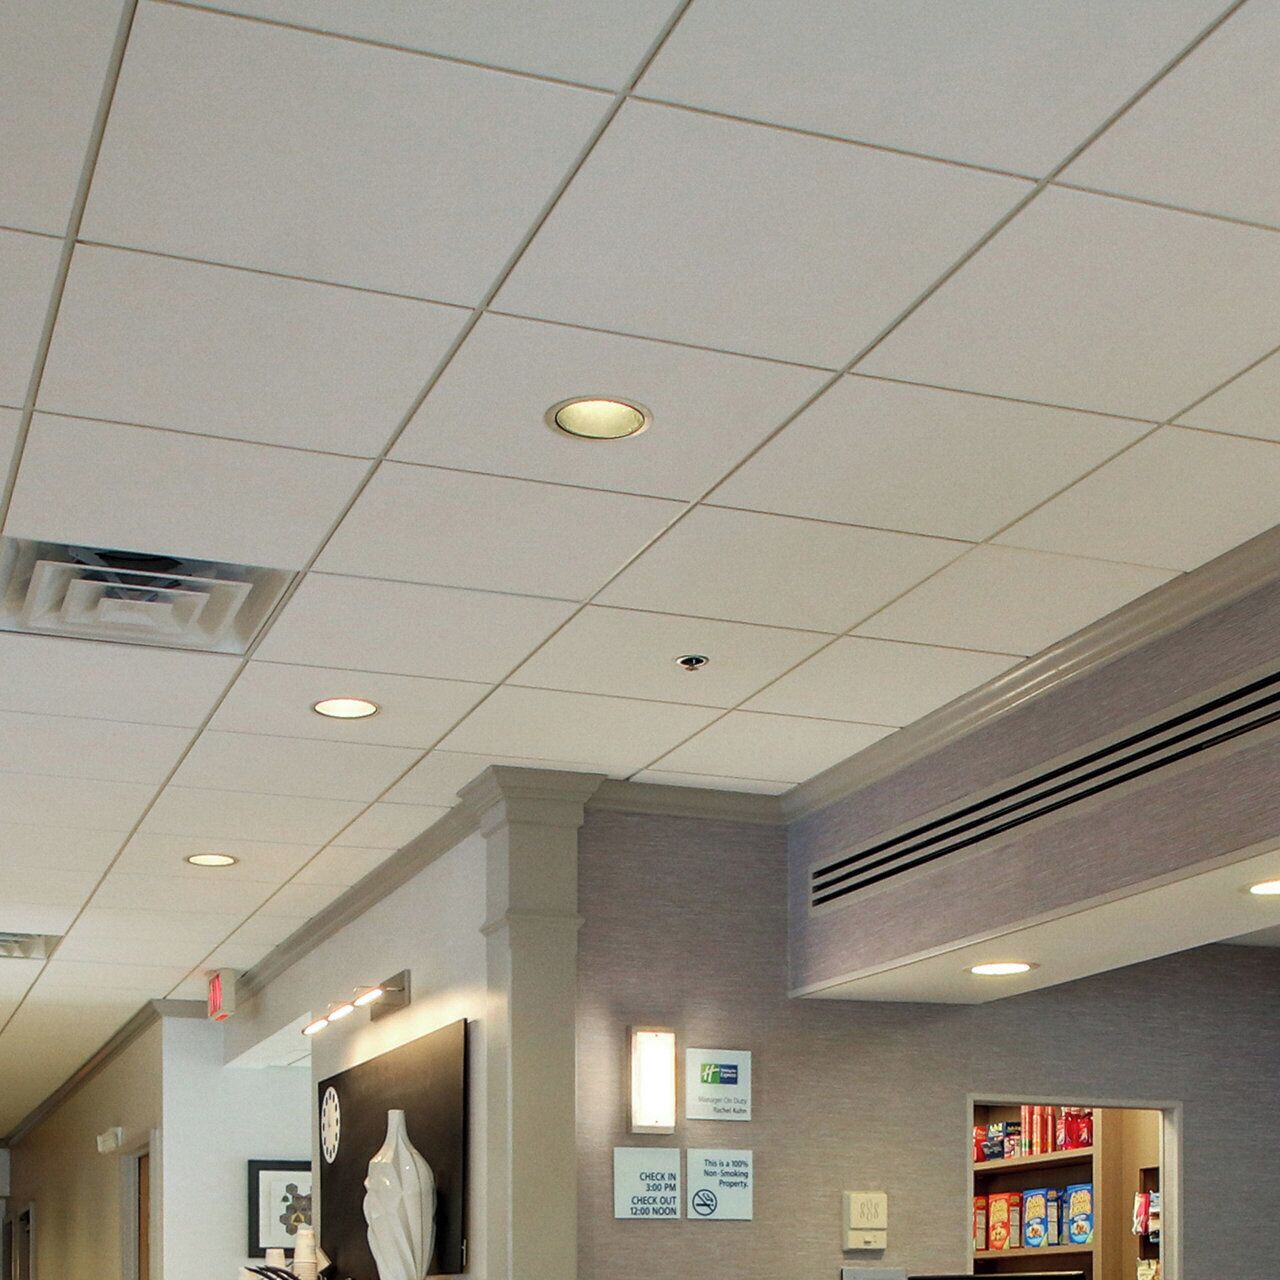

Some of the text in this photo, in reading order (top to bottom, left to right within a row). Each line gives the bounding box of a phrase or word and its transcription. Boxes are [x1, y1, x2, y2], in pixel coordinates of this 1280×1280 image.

[704, 1159, 717, 1168] This
[719, 1160, 724, 1168] is
[731, 1160, 749, 1168] 100%
[640, 1172, 677, 1182] CHECK IN
[704, 1169, 749, 1179] Non-Smoking
[646, 1183, 677, 1192] 3:00 PM
[719, 1180, 749, 1189] Property.
[631, 1196, 677, 1206] CHECK OUT
[630, 1207, 677, 1216] 12:00 NOON
